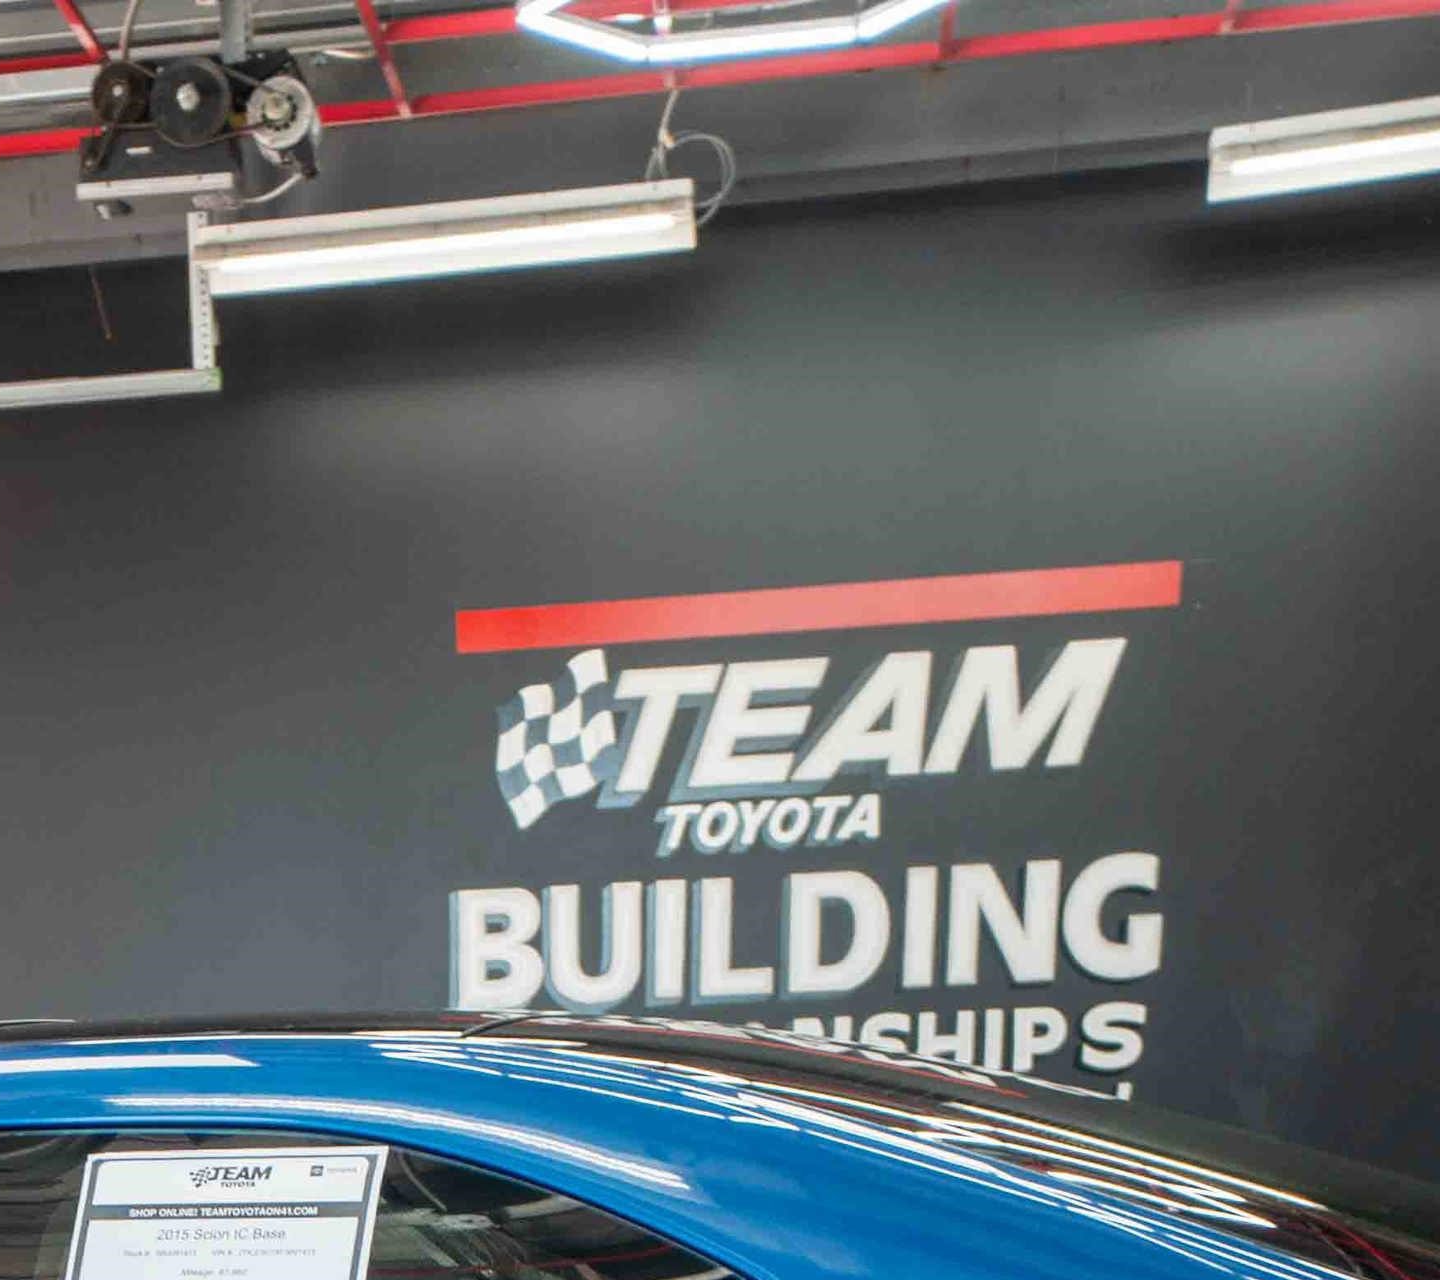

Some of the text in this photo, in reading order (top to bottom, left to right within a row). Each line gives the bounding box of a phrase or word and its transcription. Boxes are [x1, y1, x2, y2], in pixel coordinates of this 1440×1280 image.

[606, 638, 1127, 796] TEAM
[660, 793, 882, 853] TOYOTA
[452, 852, 1164, 1010] BUILDING
[210, 1166, 273, 1181] TEAM
[221, 1180, 256, 1189] TOYOTA
[129, 1208, 157, 1218] SHOP
[157, 1229, 189, 1241] 2015
[193, 1229, 229, 1241] Scion
